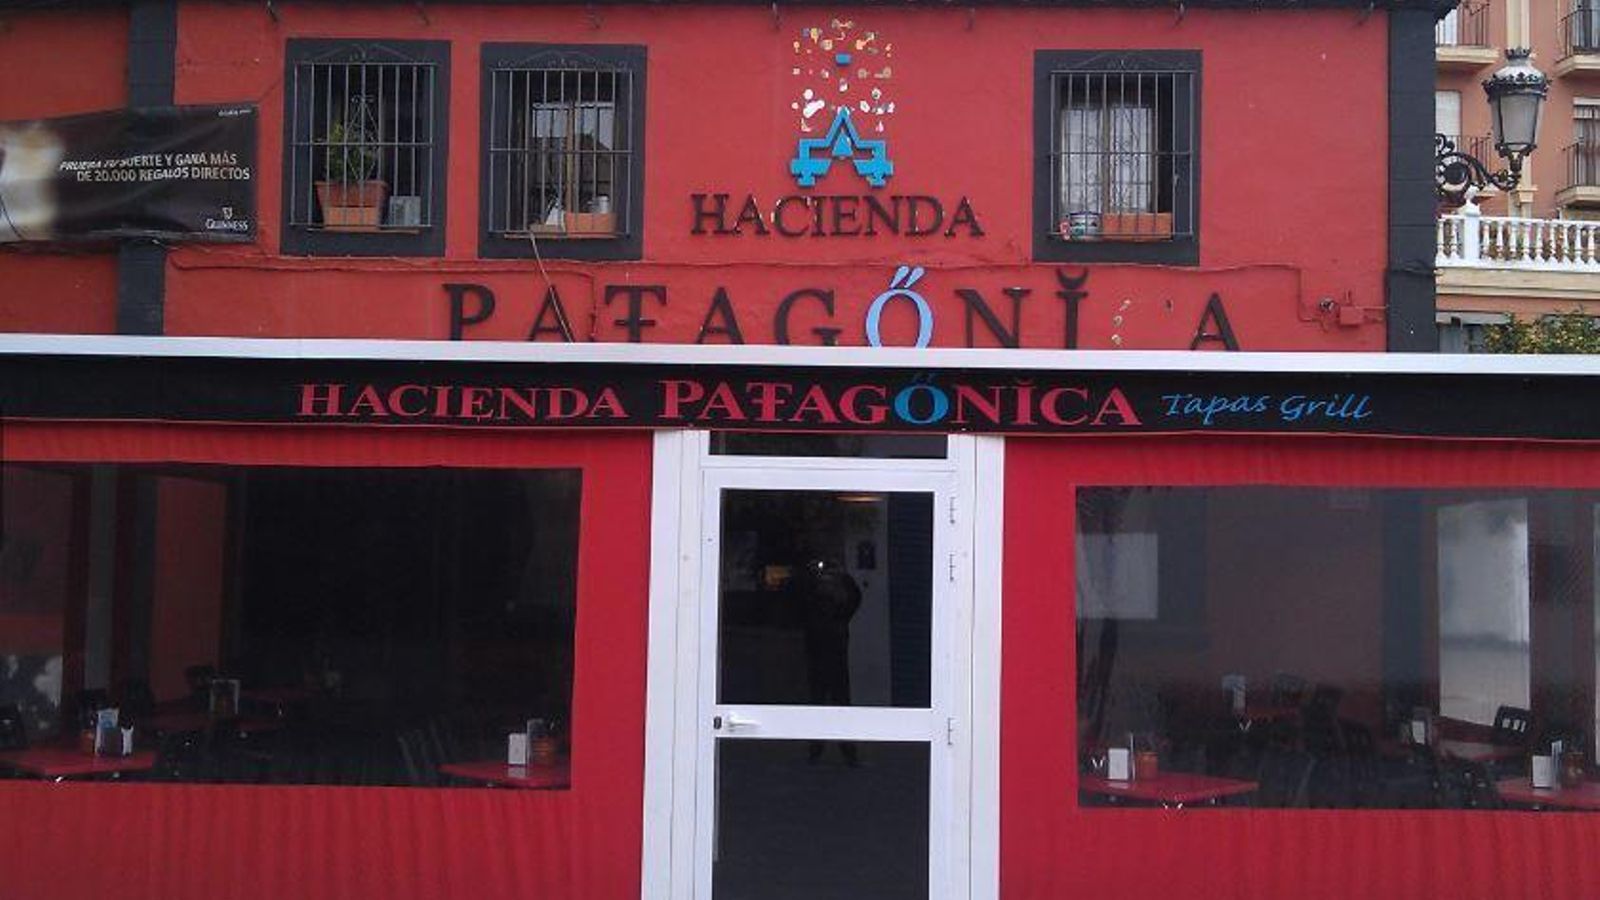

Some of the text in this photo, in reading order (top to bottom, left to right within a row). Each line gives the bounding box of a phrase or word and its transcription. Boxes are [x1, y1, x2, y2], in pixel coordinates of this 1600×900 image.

[165, 154, 174, 166] Y
[175, 153, 207, 166] GANA
[77, 167, 250, 181] DE 20.000 REGALOS DIRECTOS
[690, 193, 985, 237] HACIENDA
[297, 383, 629, 422] HACIENDA
[1162, 393, 1270, 425] Tapas
[1280, 393, 1373, 421] Grill
